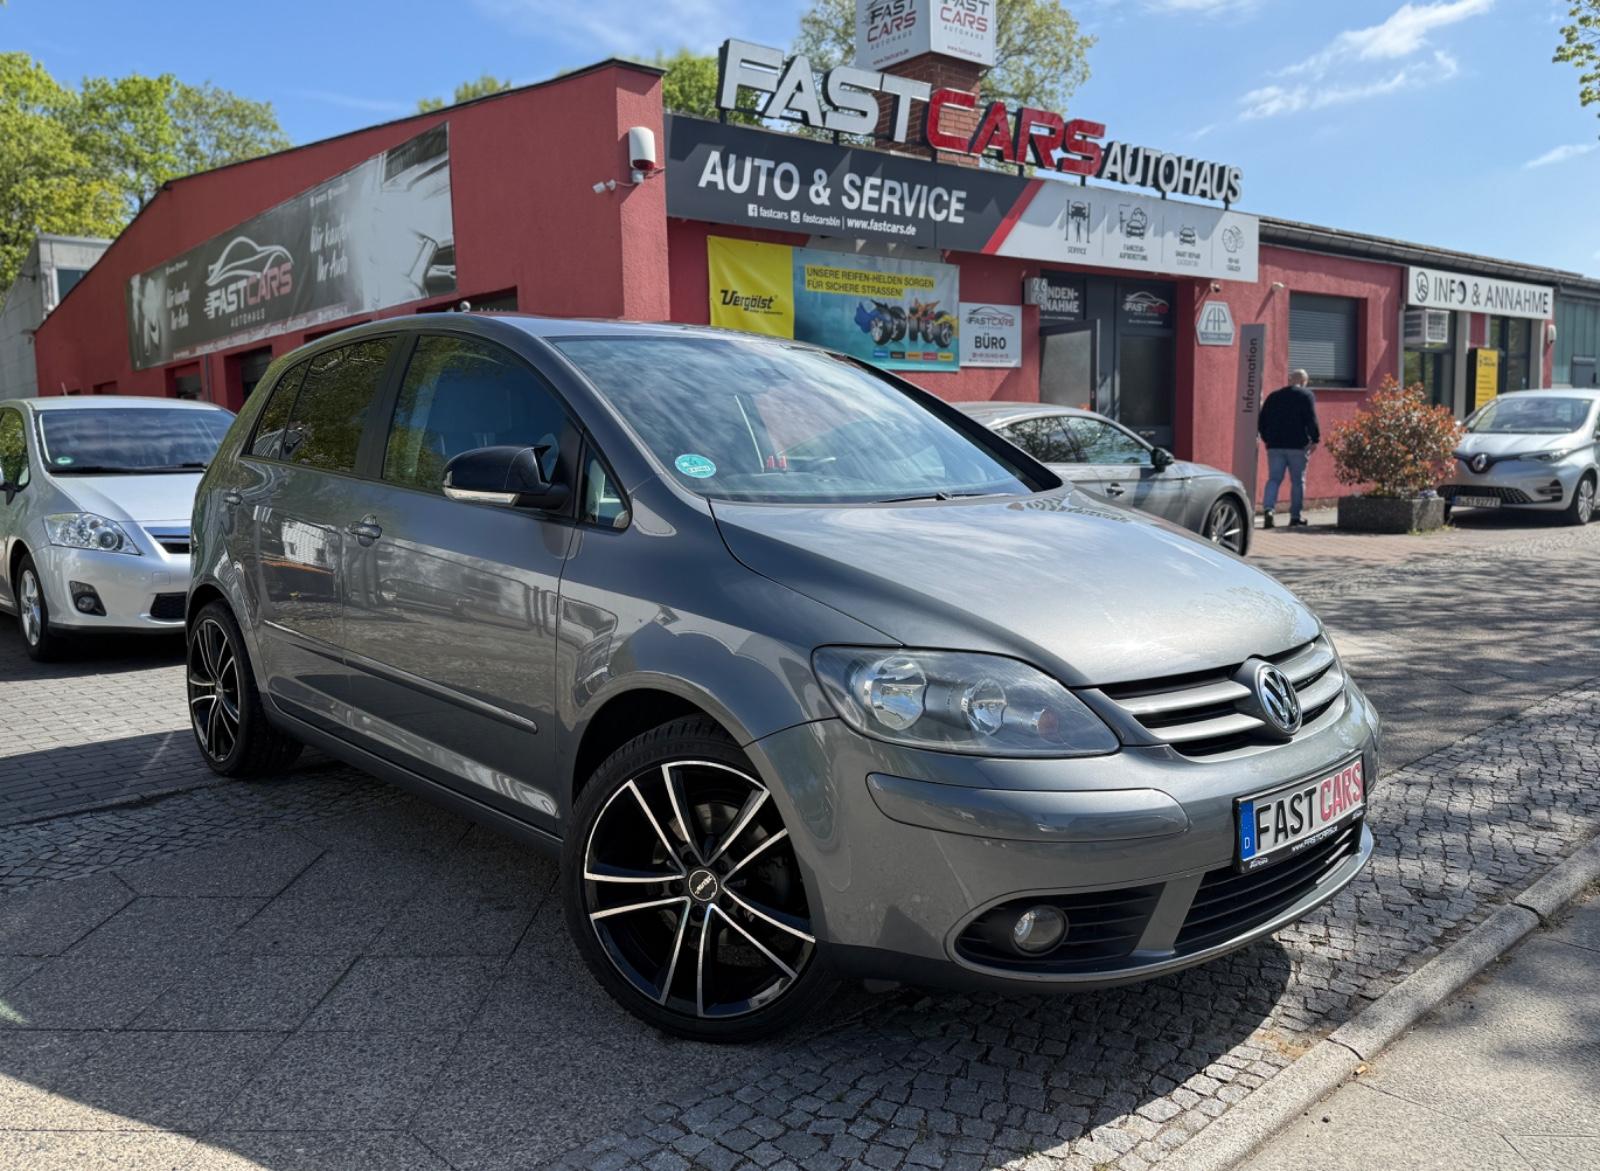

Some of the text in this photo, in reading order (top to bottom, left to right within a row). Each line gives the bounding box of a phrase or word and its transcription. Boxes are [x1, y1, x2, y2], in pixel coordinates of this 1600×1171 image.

[867, 10, 917, 43] CARS
[940, 6, 988, 32] CARS
[1102, 141, 1243, 204] AUTOHAUS
[698, 150, 967, 224] AUTO & SERVICE
[759, 207, 789, 221] fastcars
[846, 217, 917, 236] www.fastcars.de
[806, 266, 935, 289] UNSERE REIFEN-HELDEN SORGEN
[806, 278, 824, 290] FÜR
[824, 280, 861, 294] SICHERE
[720, 289, 775, 311] Vergölst
[1433, 276, 1549, 314] INFO & ANNAHME
[974, 332, 1007, 350] BÜRO
[1242, 338, 1258, 413] Information
[1244, 837, 1251, 849] D
